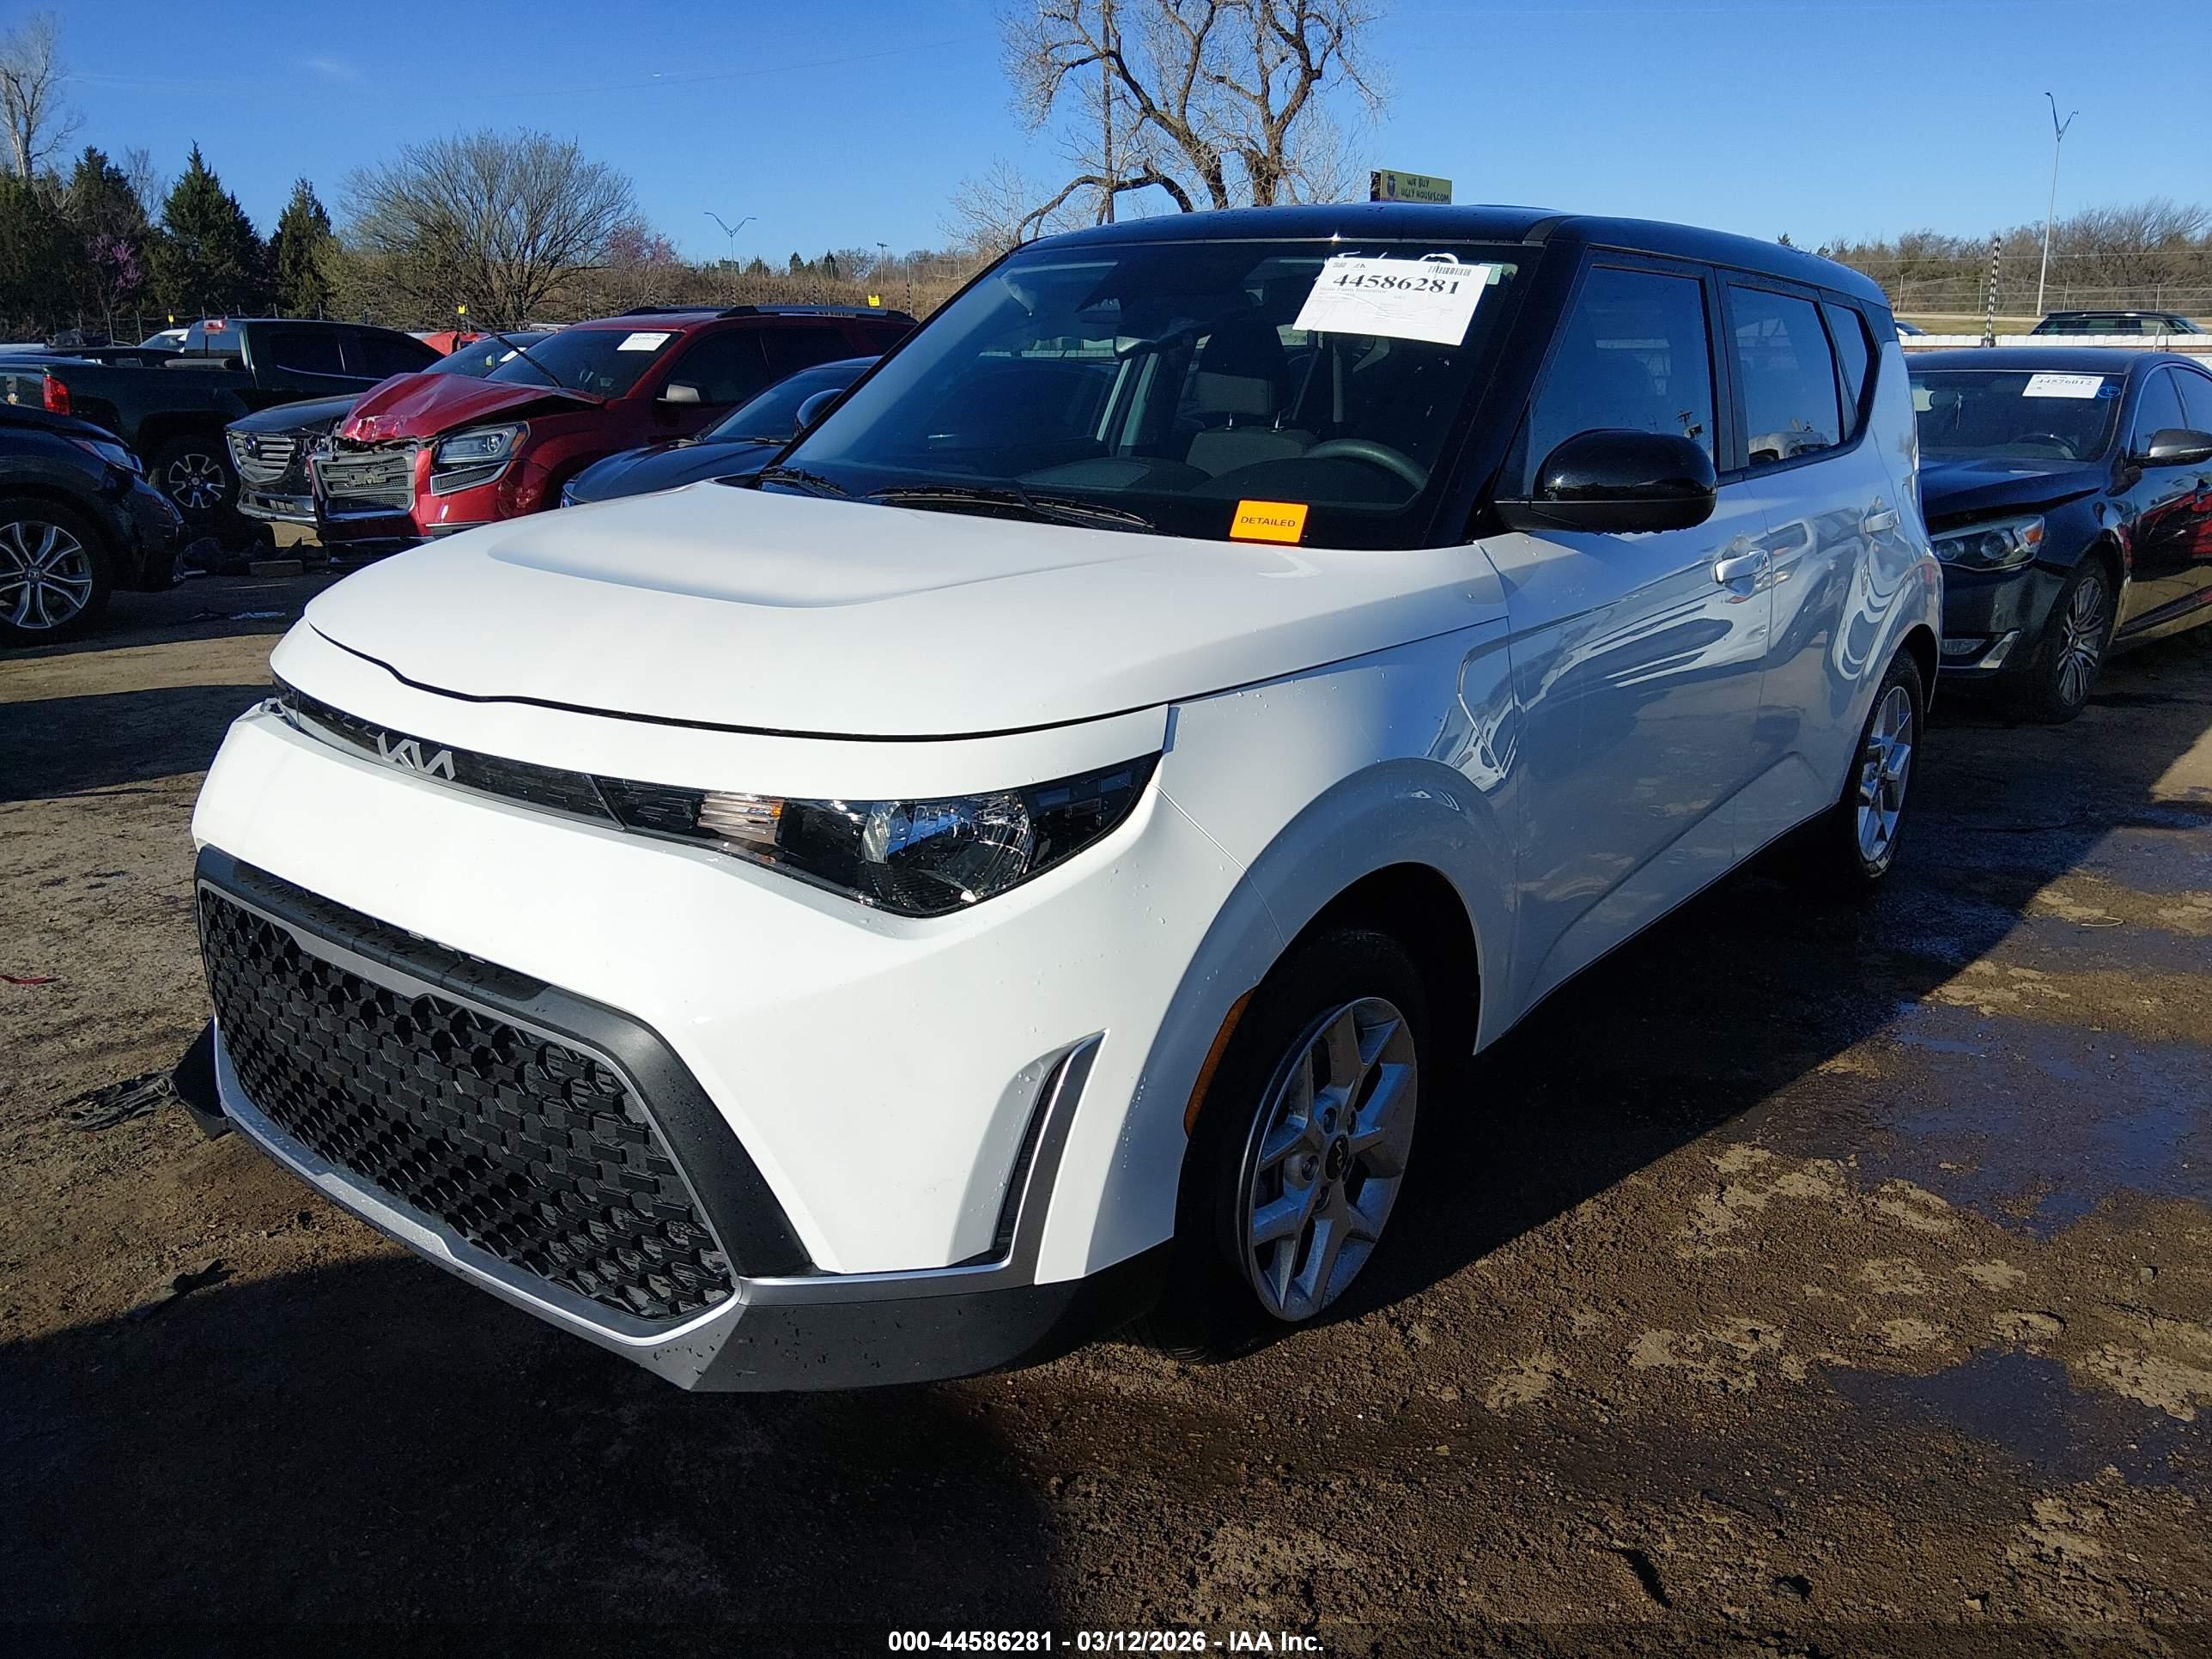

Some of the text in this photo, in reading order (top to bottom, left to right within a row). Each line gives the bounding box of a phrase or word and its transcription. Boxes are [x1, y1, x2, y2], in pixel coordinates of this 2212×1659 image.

[1407, 178, 1430, 188] WE BUY
[1401, 187, 1449, 202] UGLY HOUSES.COM
[1333, 273, 1460, 295] 44586281
[1240, 516, 1296, 527] DETAILED
